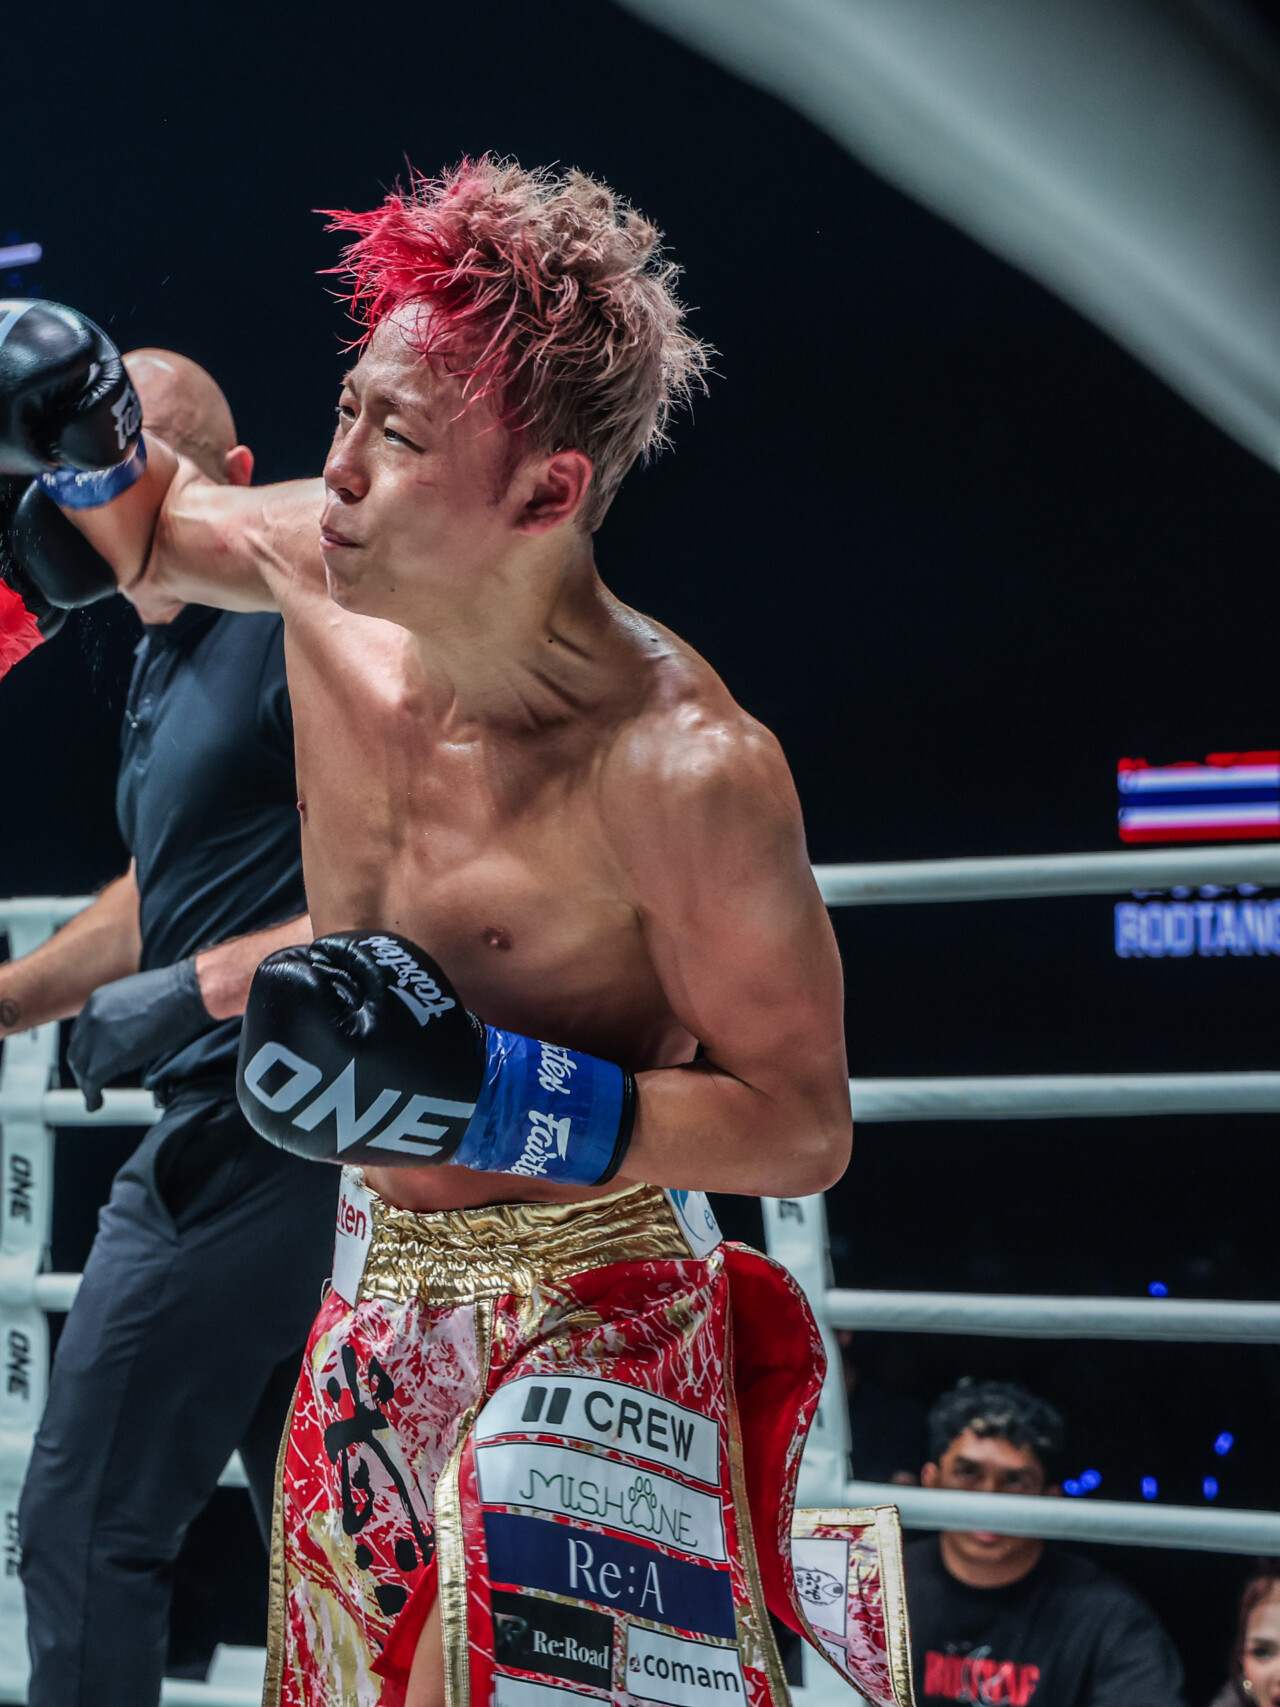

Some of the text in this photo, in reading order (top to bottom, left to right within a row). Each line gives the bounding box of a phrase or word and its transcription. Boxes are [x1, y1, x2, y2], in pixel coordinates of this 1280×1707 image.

[357, 935, 457, 1028] Fairtex
[243, 1041, 478, 1158] ONE
[8, 1153, 34, 1225] ONE
[5, 1328, 32, 1403] ONE
[583, 1390, 695, 1462] CREW
[567, 1537, 665, 1615] Re:A
[532, 1629, 611, 1671] Re:Road
